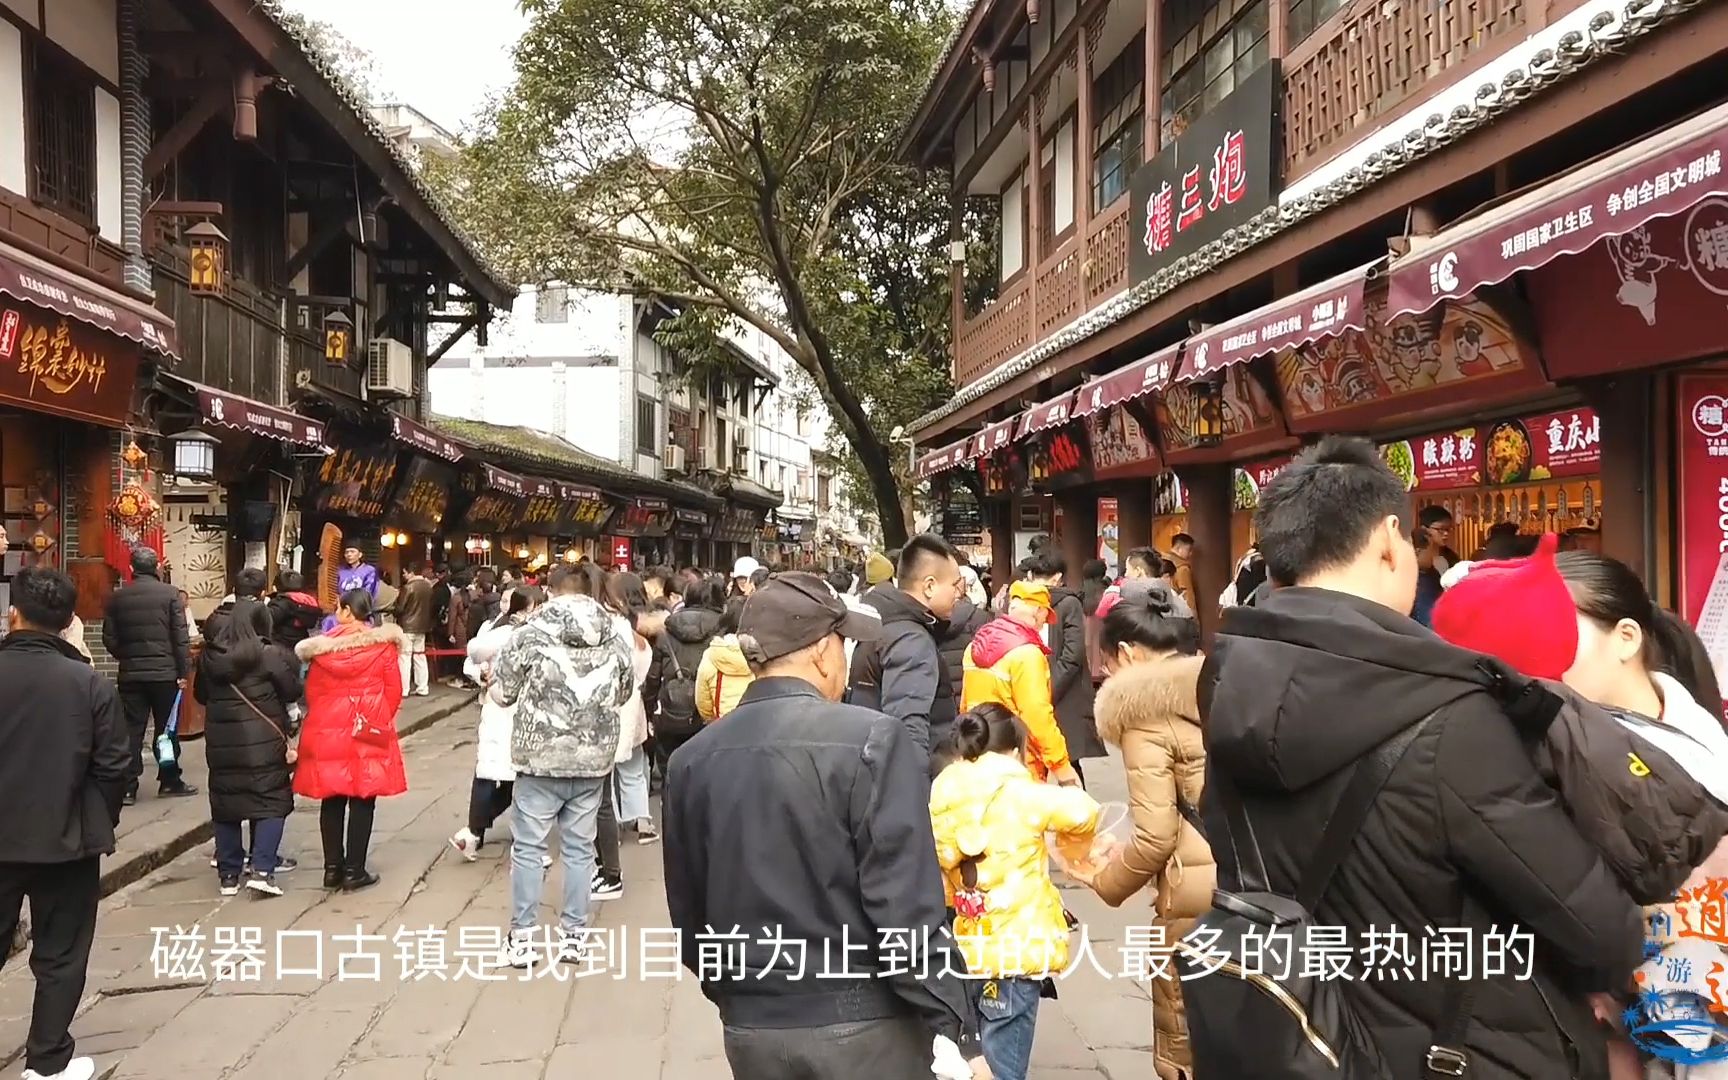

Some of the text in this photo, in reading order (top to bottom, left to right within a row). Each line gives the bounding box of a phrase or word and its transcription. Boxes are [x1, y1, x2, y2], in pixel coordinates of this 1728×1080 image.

[1501, 150, 1721, 259] 巩固国家卫生区 争创全国文明城
[1423, 435, 1476, 468] 酸辣粉
